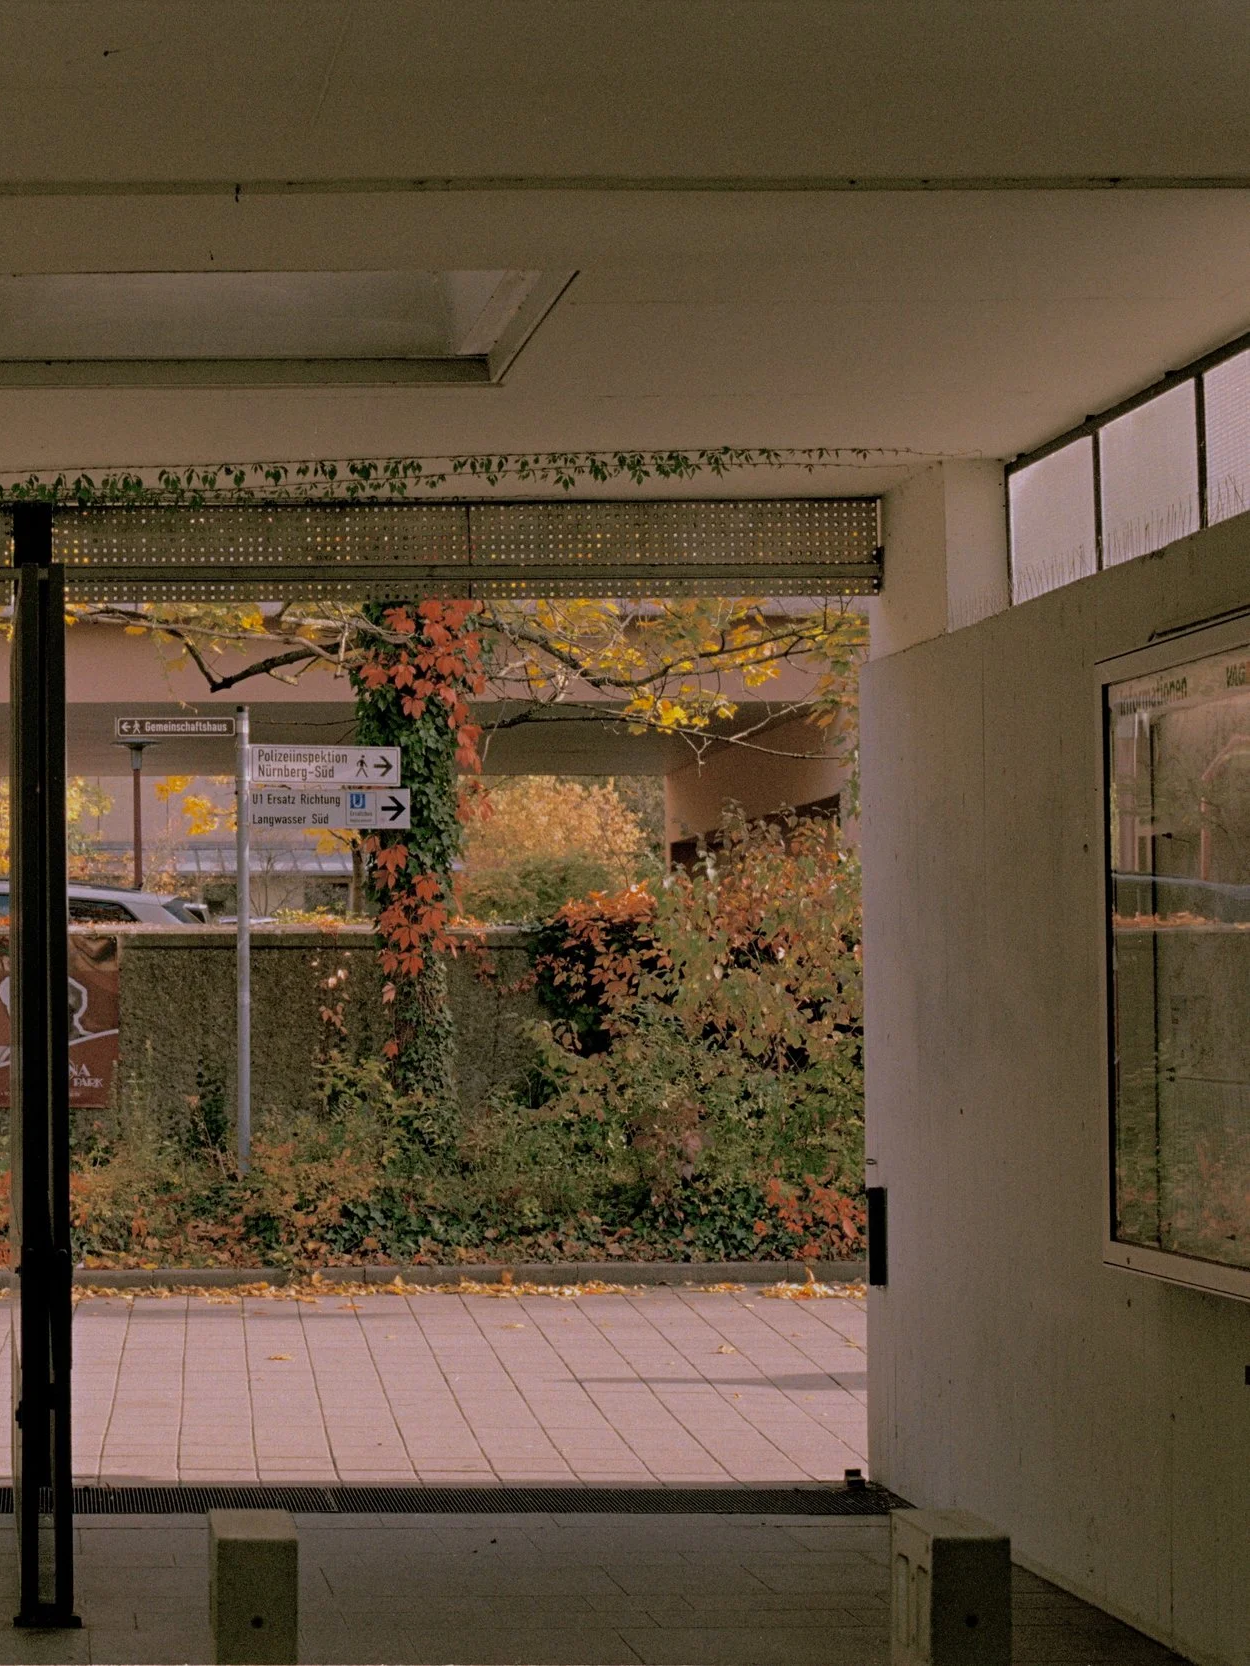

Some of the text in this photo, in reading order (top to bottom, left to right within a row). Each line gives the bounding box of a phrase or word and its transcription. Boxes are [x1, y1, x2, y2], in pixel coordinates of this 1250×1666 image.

[1226, 662, 1246, 688] VAG
[144, 721, 227, 732] Gemeinschaftshaus
[257, 749, 348, 766] Polizeiinspektion
[257, 764, 335, 781] Nürnberg-Süd
[252, 794, 341, 807] U1 Ersatz Richtung
[252, 813, 329, 827] Langwasser Süd
[72, 1077, 103, 1088] PARK
